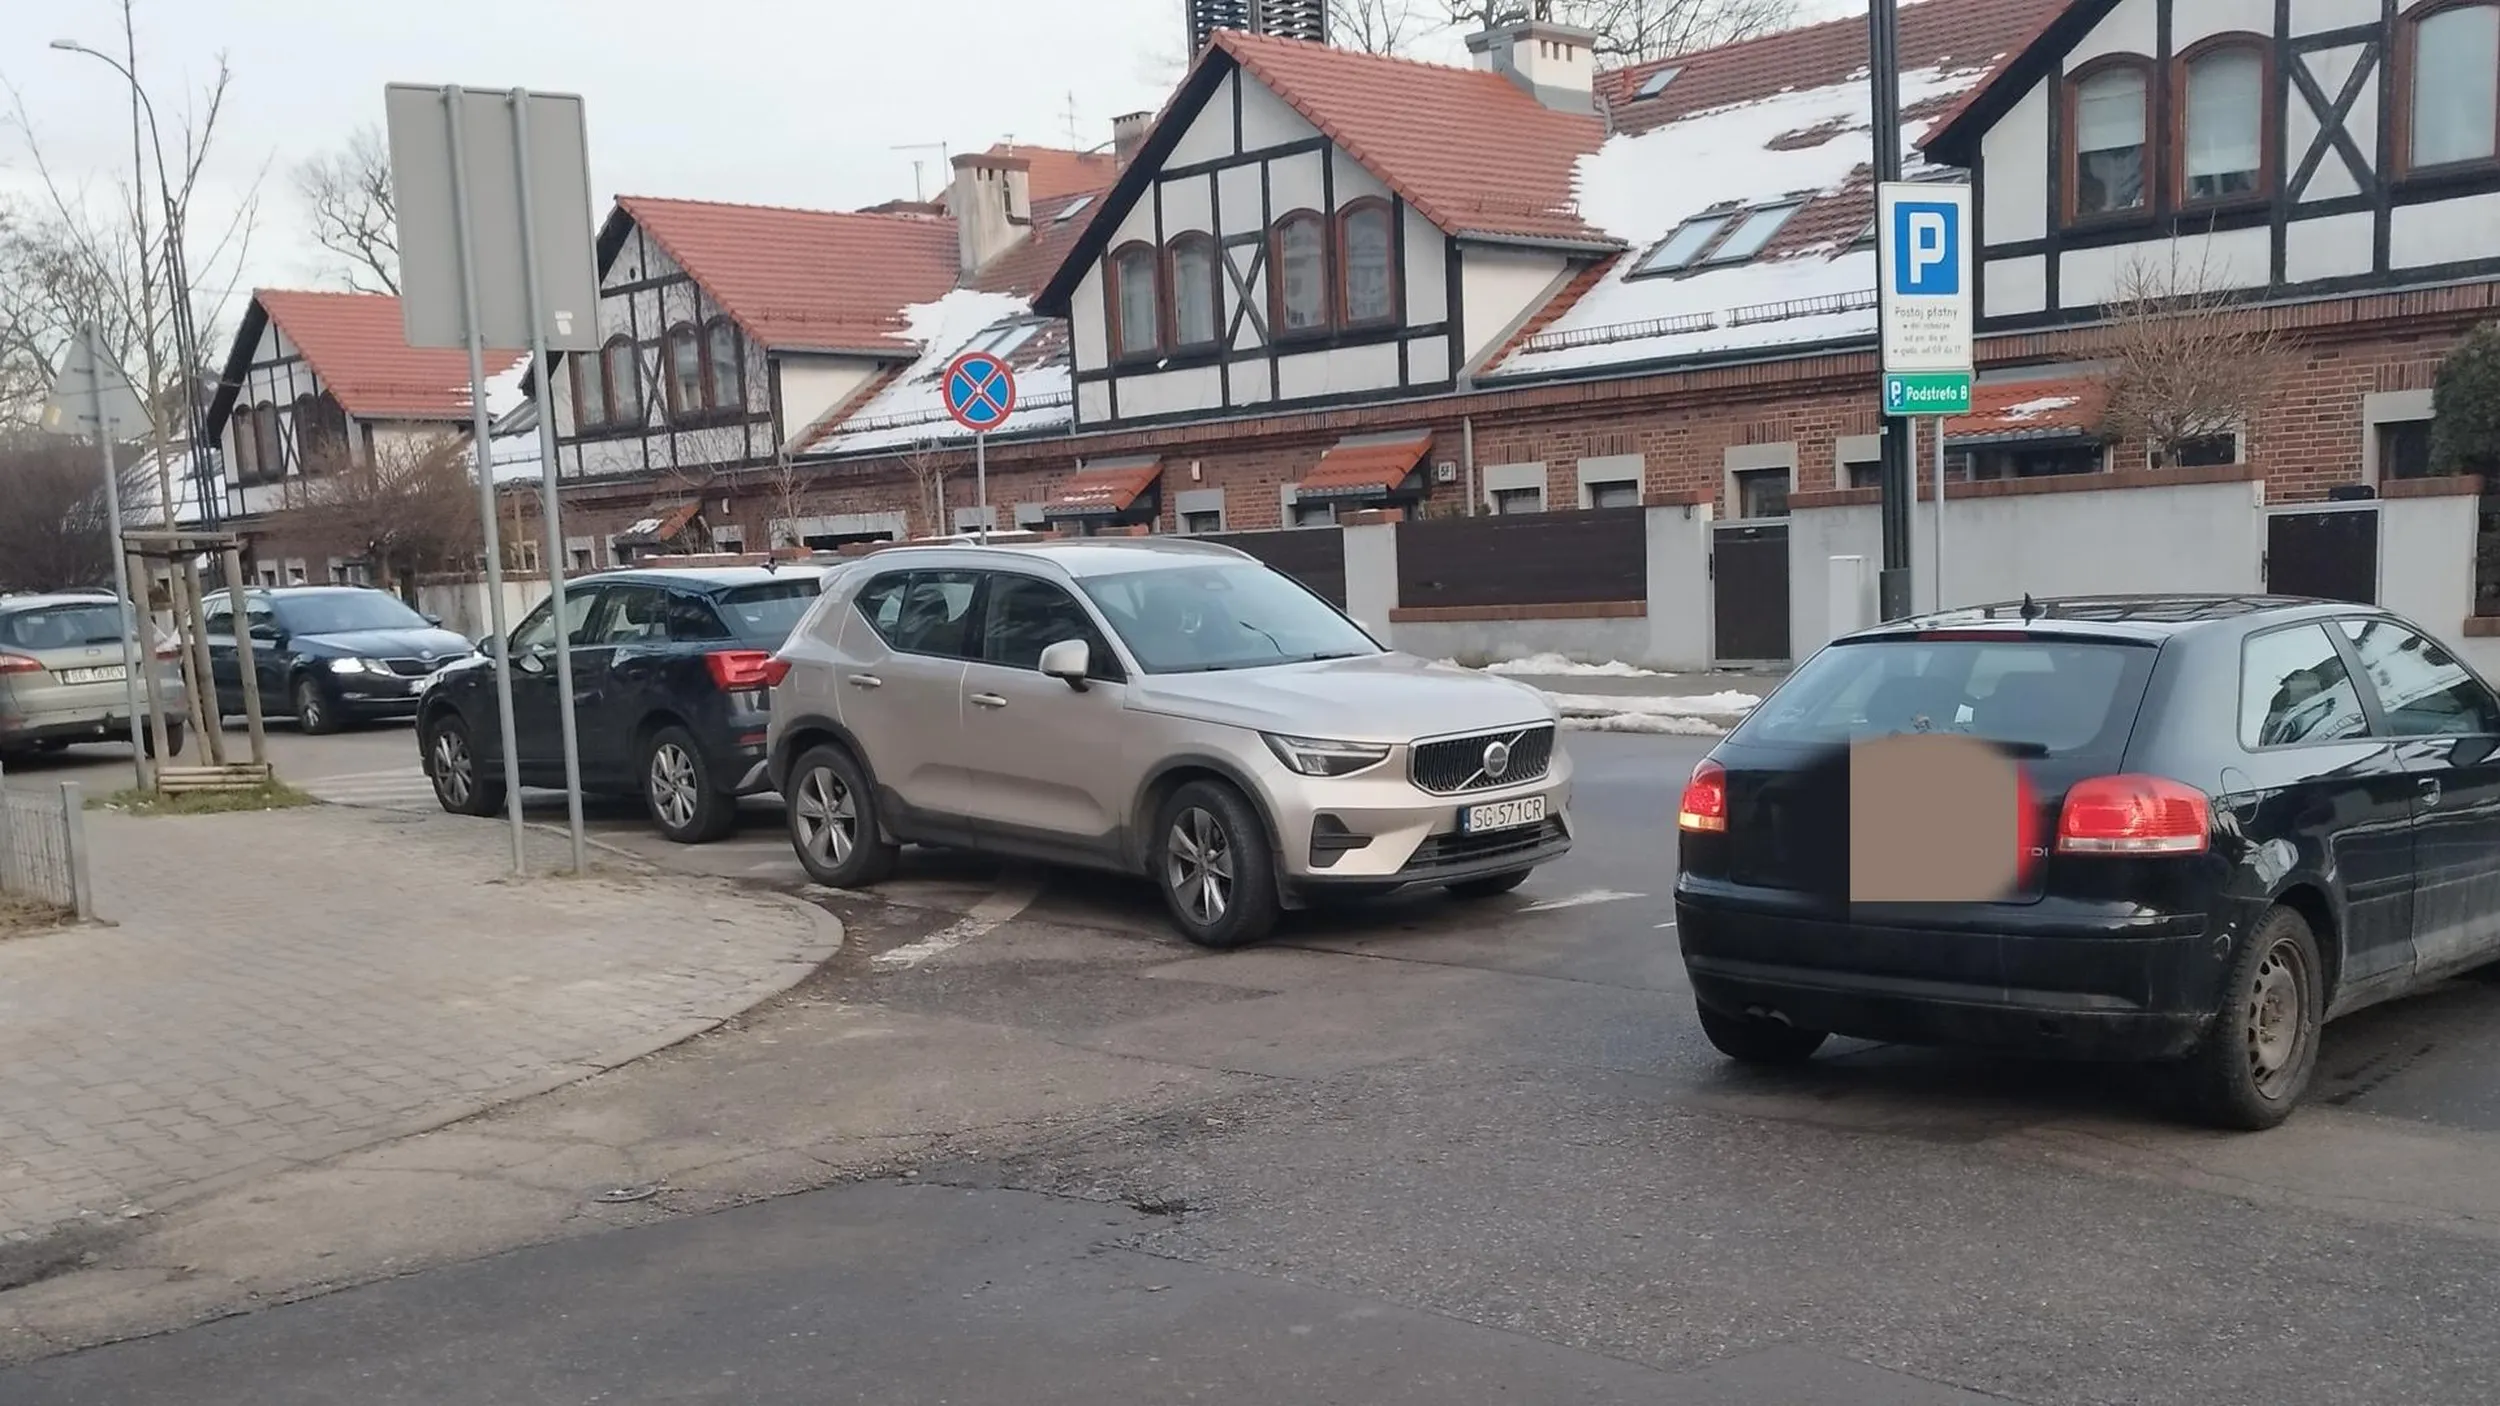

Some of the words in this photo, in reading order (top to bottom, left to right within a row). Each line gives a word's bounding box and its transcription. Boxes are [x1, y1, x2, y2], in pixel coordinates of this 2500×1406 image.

[1909, 212, 1945, 284] P
[1906, 385, 1957, 401] Podstrefa
[1961, 384, 1968, 400] B
[1474, 807, 1493, 829] SG
[1498, 798, 1542, 825] 571CR
